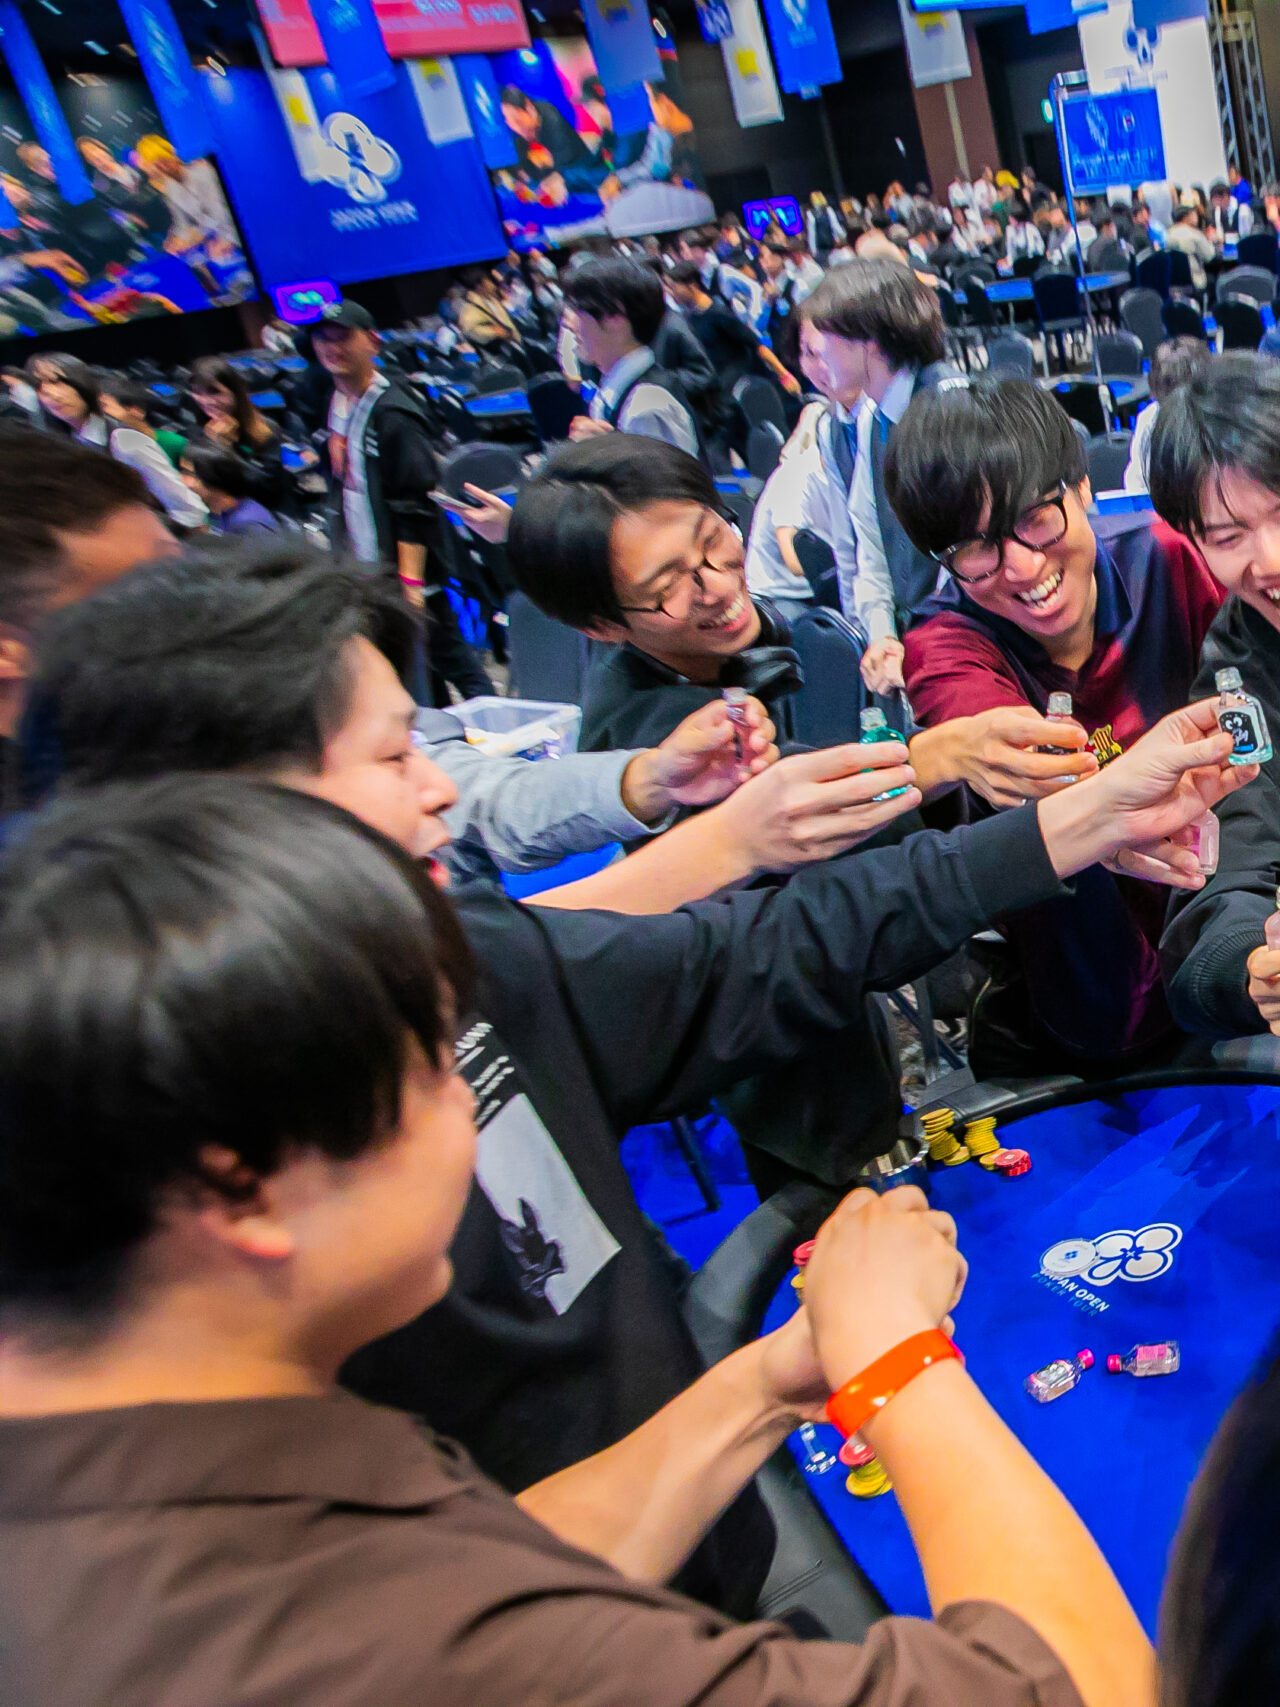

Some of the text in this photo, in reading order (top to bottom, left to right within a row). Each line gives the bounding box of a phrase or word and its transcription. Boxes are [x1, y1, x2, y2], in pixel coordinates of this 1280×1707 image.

[1031, 1272, 1098, 1317] POKER TOUR
[1075, 1288, 1110, 1312] OPEN
